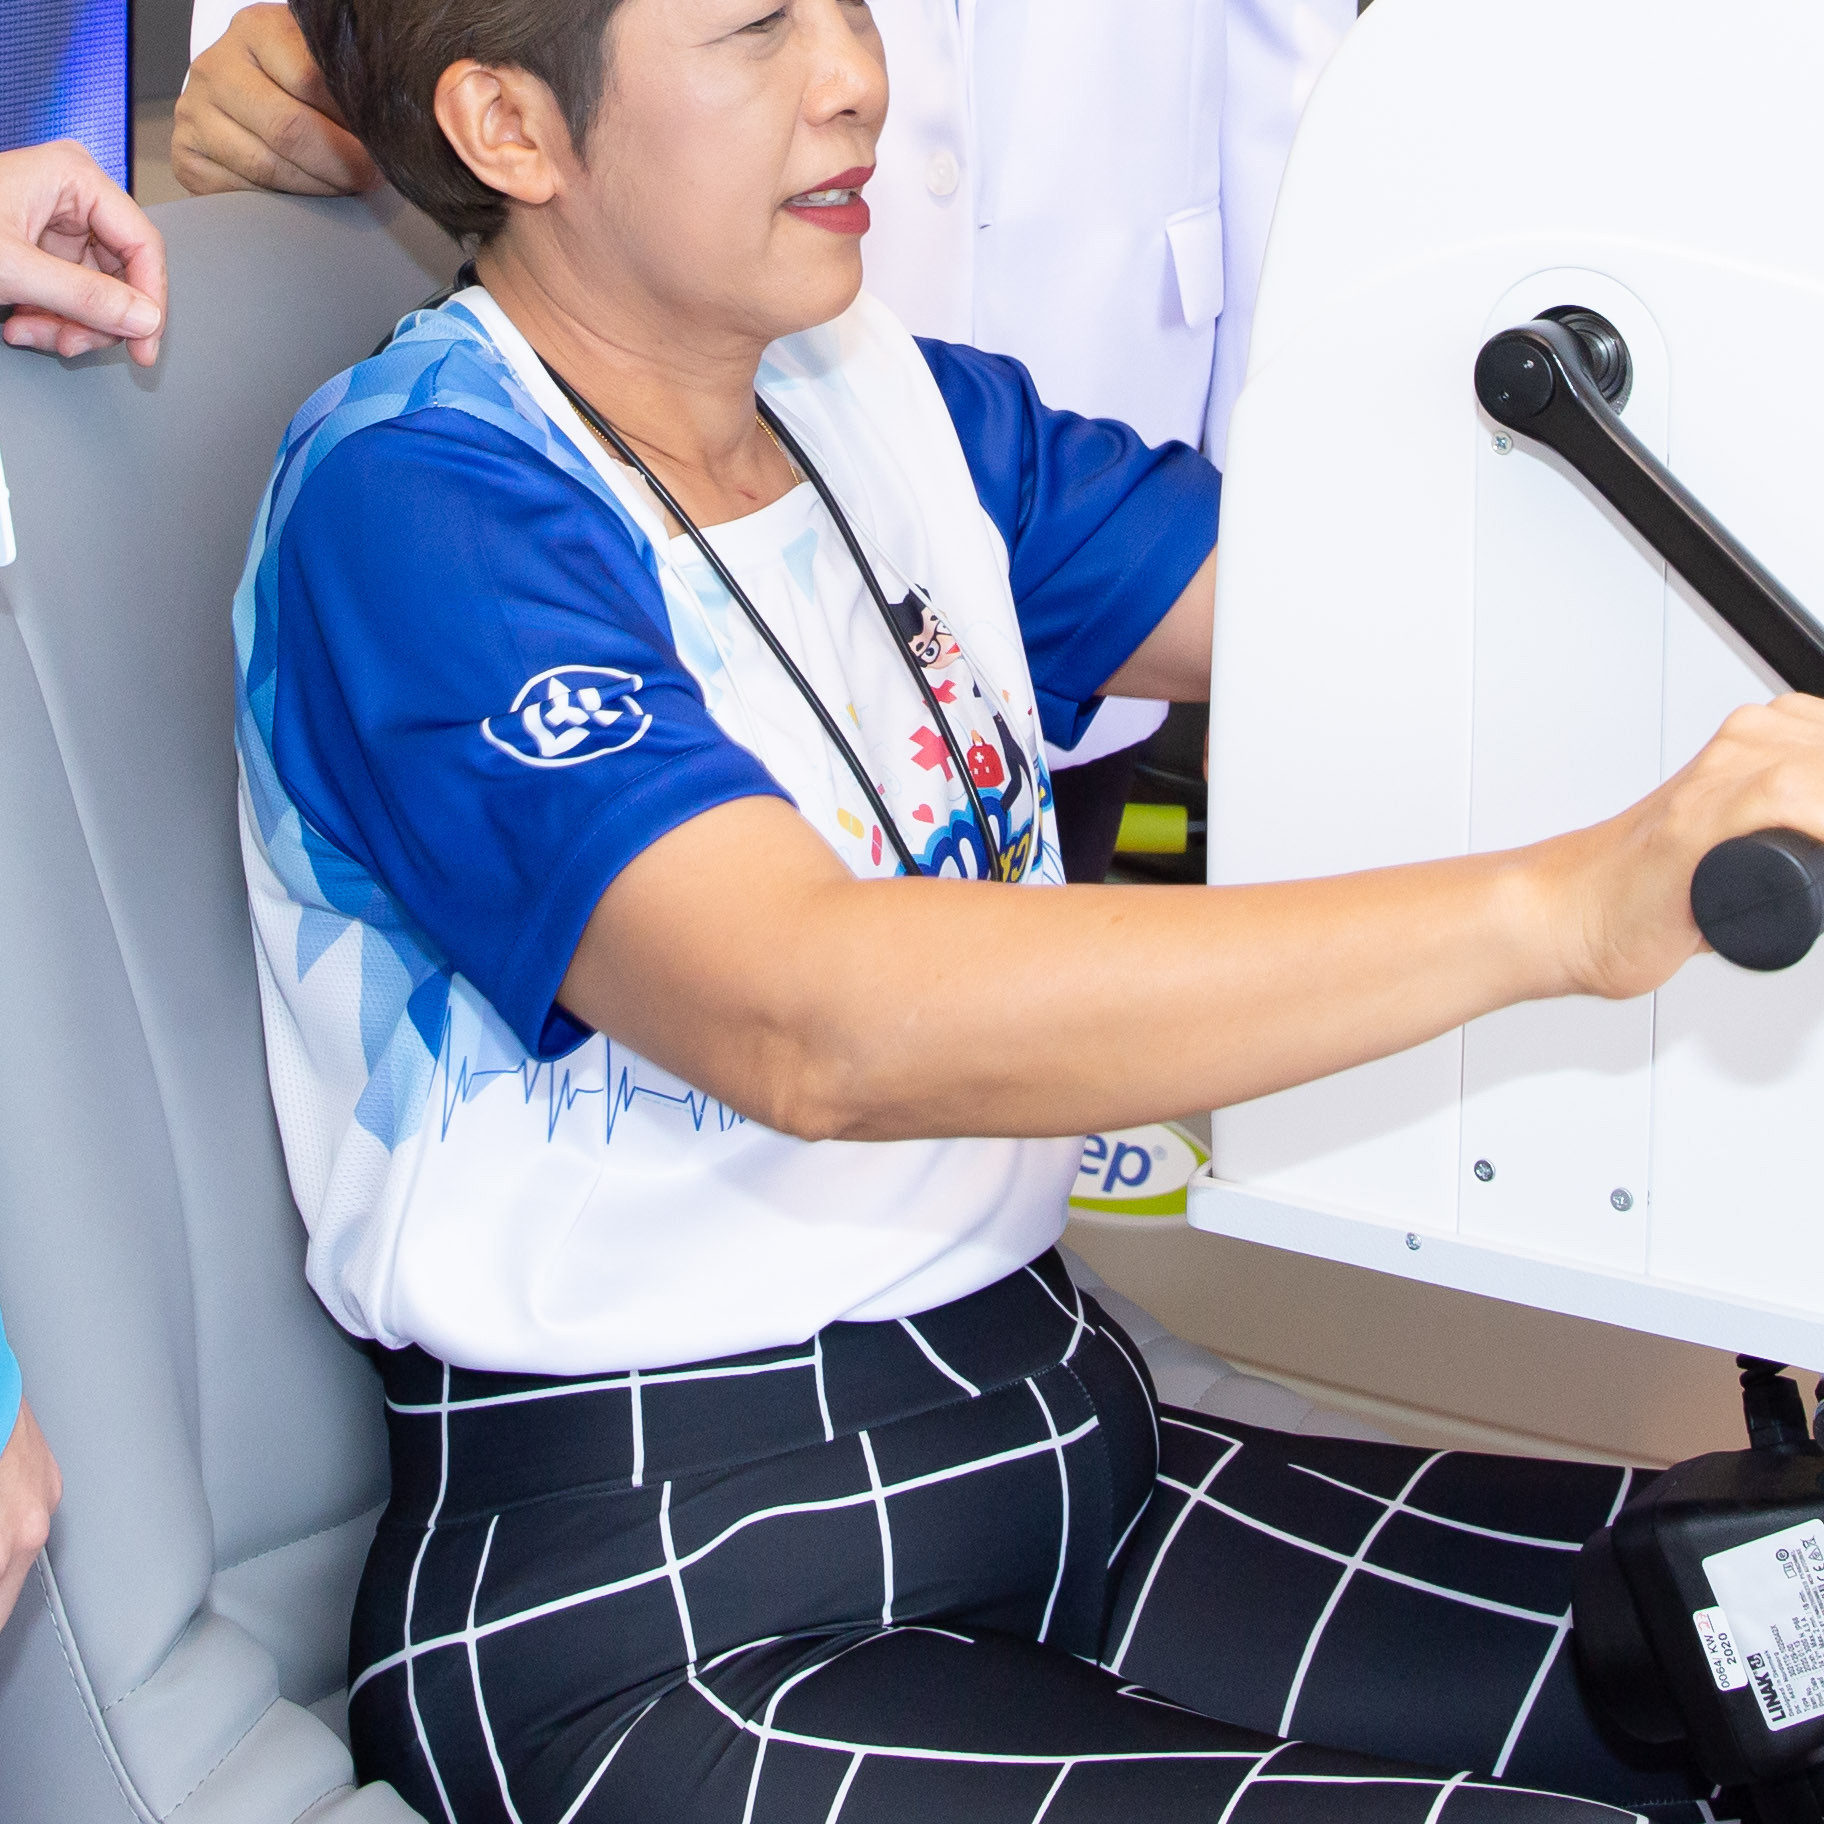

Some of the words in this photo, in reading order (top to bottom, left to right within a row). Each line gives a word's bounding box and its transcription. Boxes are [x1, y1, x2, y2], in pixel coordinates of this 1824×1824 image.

[1703, 1632, 1718, 1654] KW
[1718, 1632, 1736, 1665] 2020
[1757, 1672, 1786, 1721] LINAK
